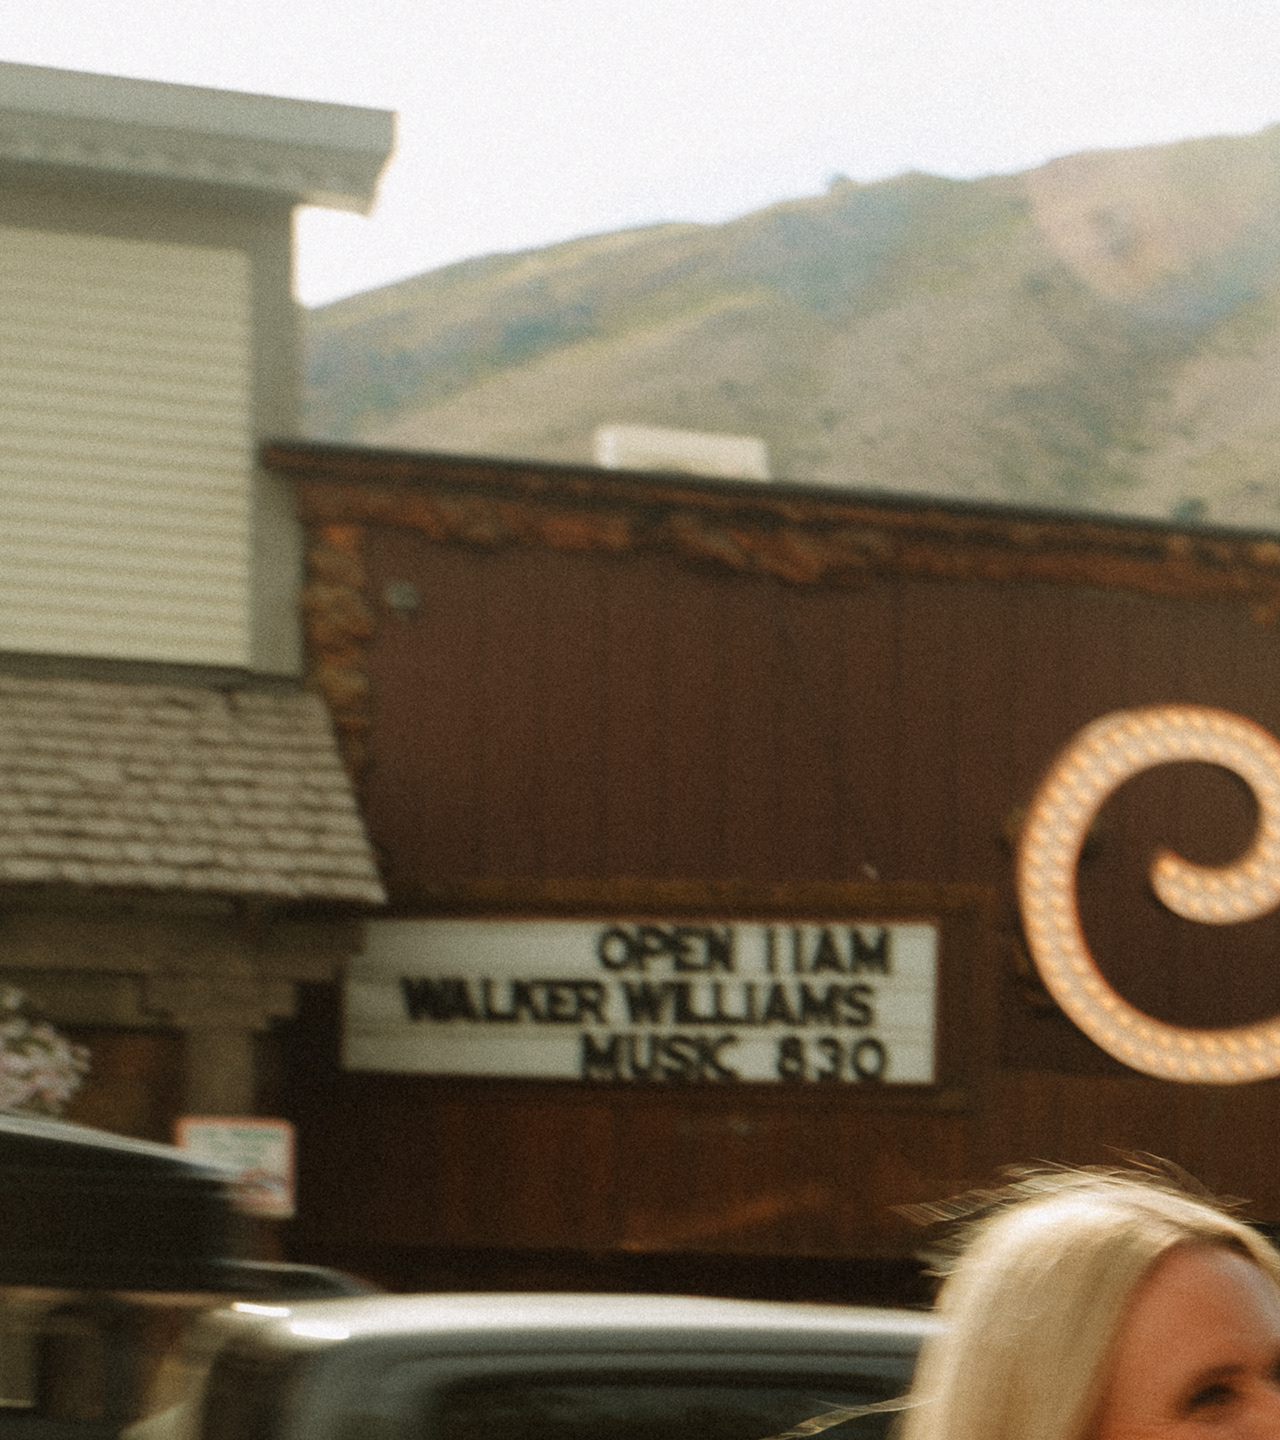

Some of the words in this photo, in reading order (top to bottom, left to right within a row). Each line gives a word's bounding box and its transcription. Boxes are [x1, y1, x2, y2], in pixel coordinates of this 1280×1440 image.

[600, 925, 736, 974] OPEN
[401, 976, 607, 1025] WALKER
[618, 979, 876, 1029] WILLIAMS
[580, 1034, 738, 1081] MUSIC
